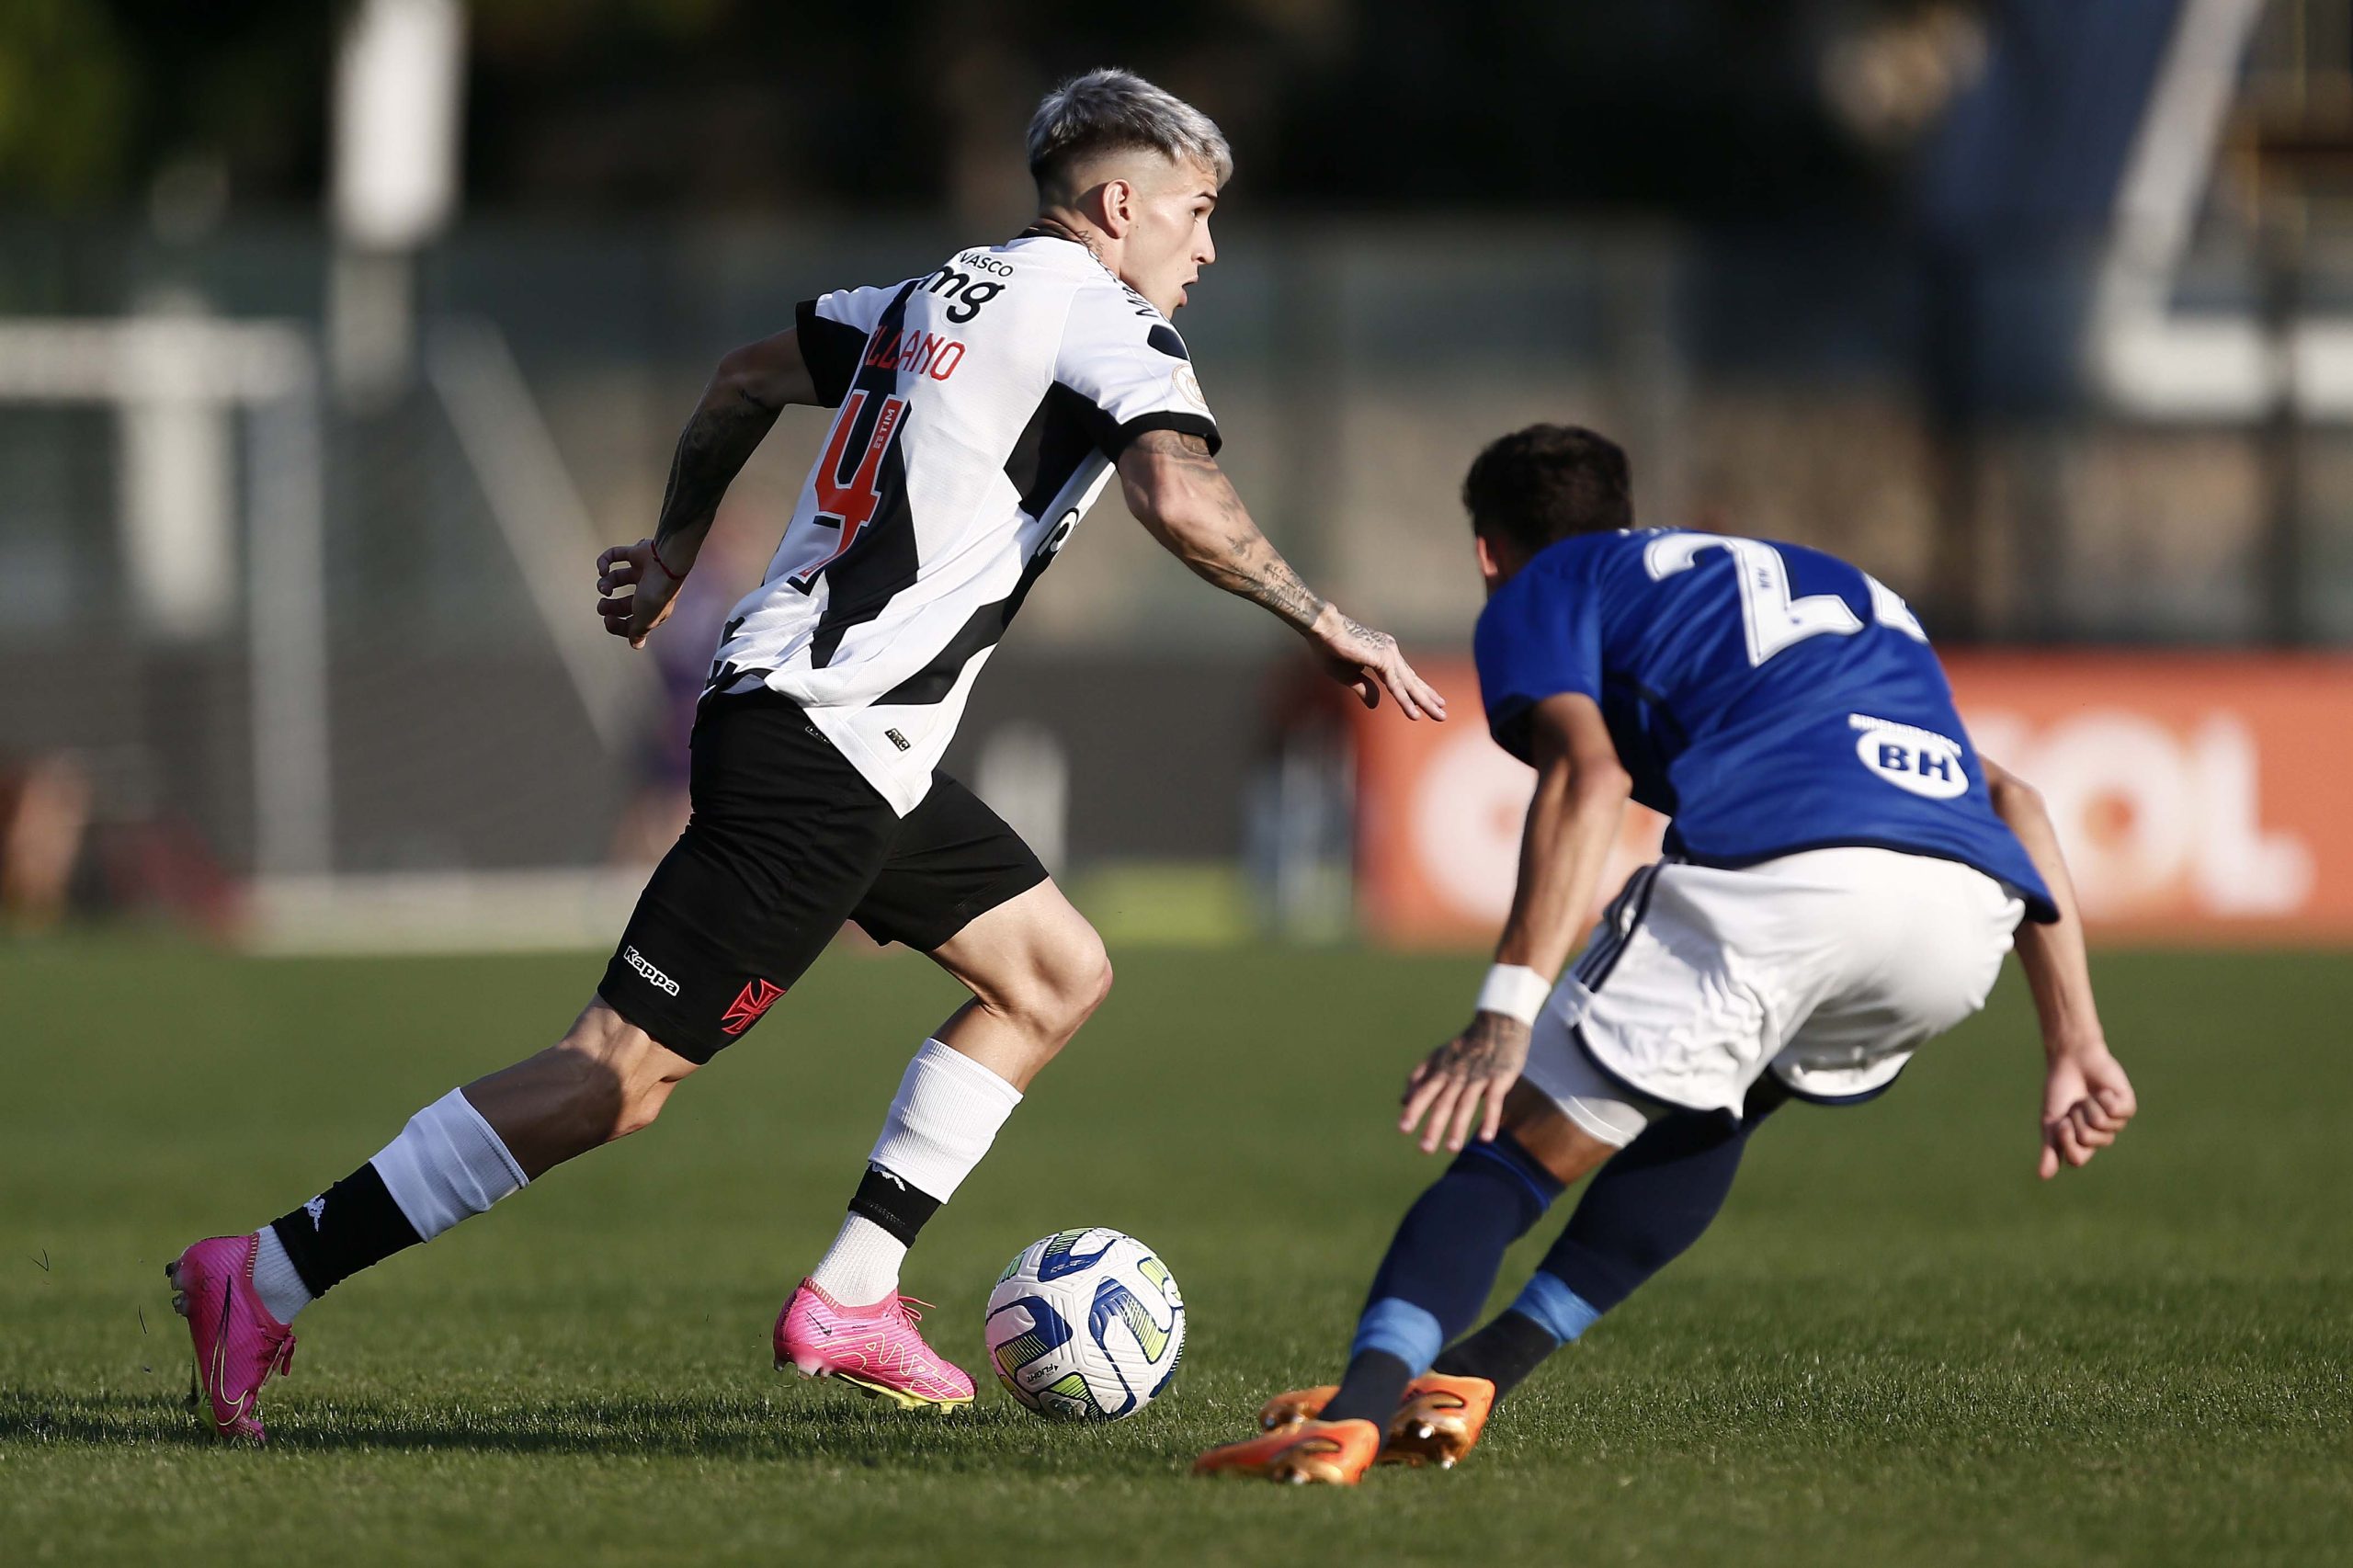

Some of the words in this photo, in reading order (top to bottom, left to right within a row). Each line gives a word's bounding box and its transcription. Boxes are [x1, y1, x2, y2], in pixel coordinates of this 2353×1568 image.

[960, 253, 1014, 277] VASCO
[1879, 743, 1951, 783] BH
[623, 945, 680, 997] Kappa
[1027, 1363, 1053, 1382] FLIGHT
